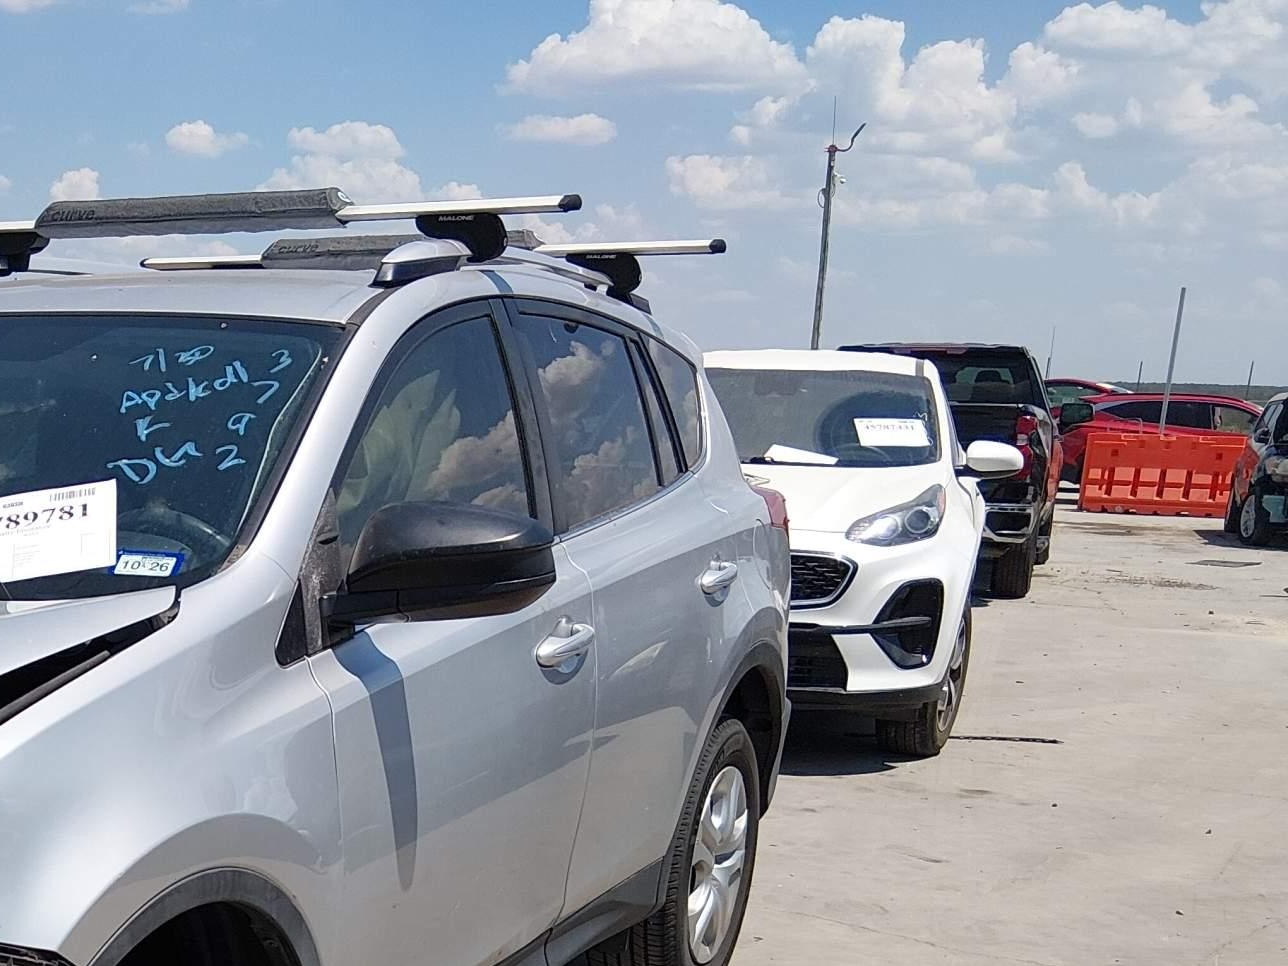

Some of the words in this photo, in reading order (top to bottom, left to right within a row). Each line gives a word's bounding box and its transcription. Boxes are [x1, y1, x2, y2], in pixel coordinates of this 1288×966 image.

[438, 214, 475, 222] MALONE
[122, 560, 141, 570] 10
[149, 561, 170, 572] 26
